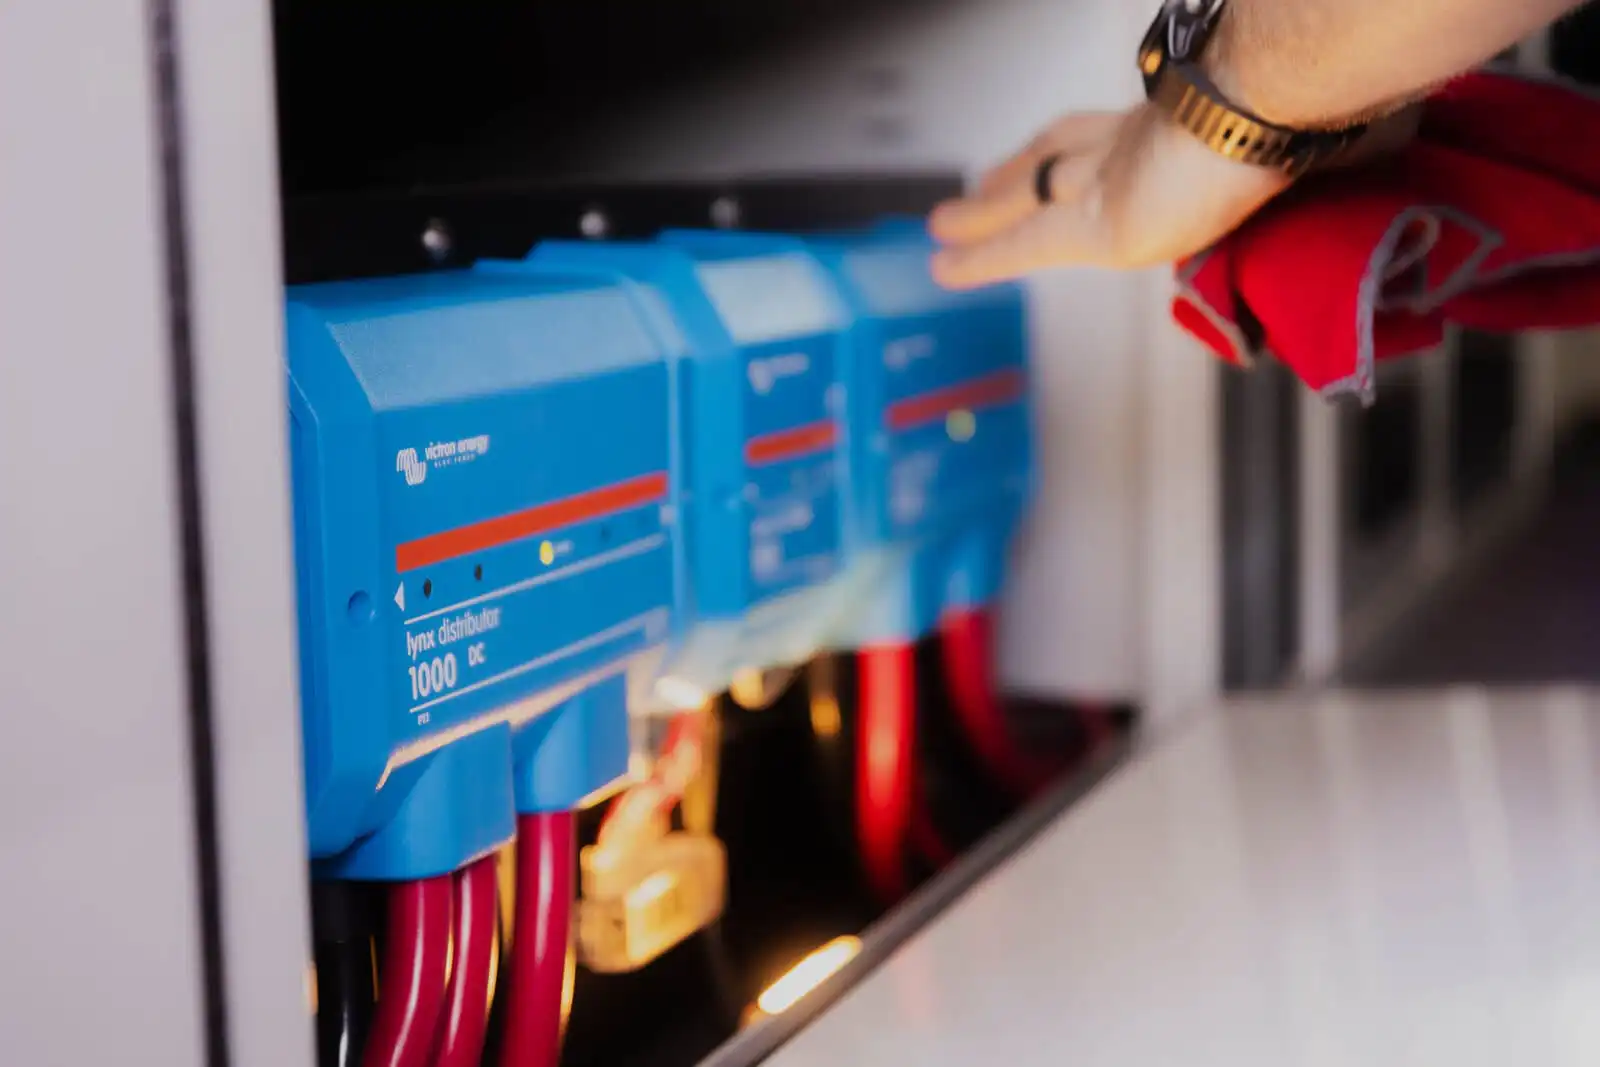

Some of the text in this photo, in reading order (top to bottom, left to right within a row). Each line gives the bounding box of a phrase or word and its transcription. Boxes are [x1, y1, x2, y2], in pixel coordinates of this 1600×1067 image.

[425, 441, 455, 460] victron
[407, 608, 499, 661] lynx distributor
[408, 642, 485, 700] 1000 DC
